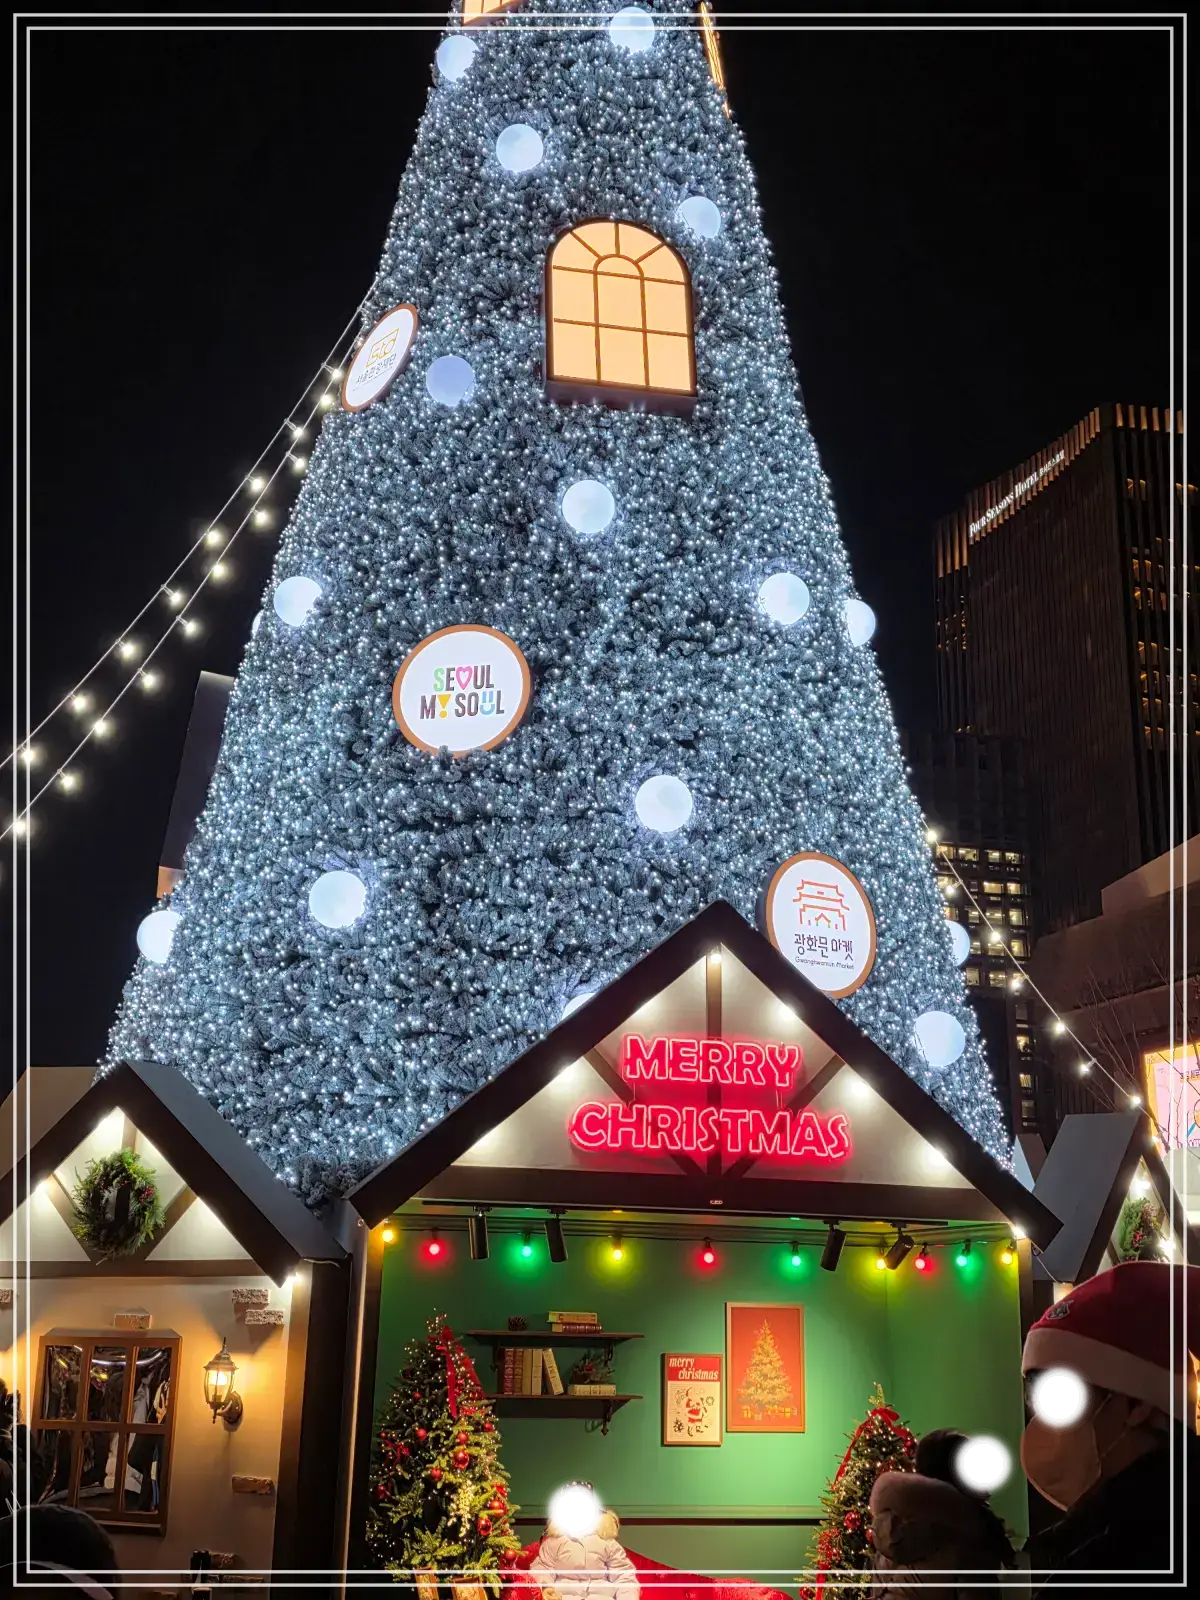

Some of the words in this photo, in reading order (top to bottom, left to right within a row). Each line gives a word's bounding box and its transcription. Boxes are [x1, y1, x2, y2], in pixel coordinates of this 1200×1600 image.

[986, 492, 1014, 521] SEASONS
[1015, 471, 1038, 499] HOTEL
[454, 690, 505, 718] SOUL
[794, 933, 829, 958] 광화문
[831, 938, 854, 961] 마켓
[623, 1035, 800, 1088] MERRY
[570, 1101, 850, 1159] CHRISTMAS
[669, 1357, 695, 1369] merry
[678, 1367, 719, 1380] christmas
